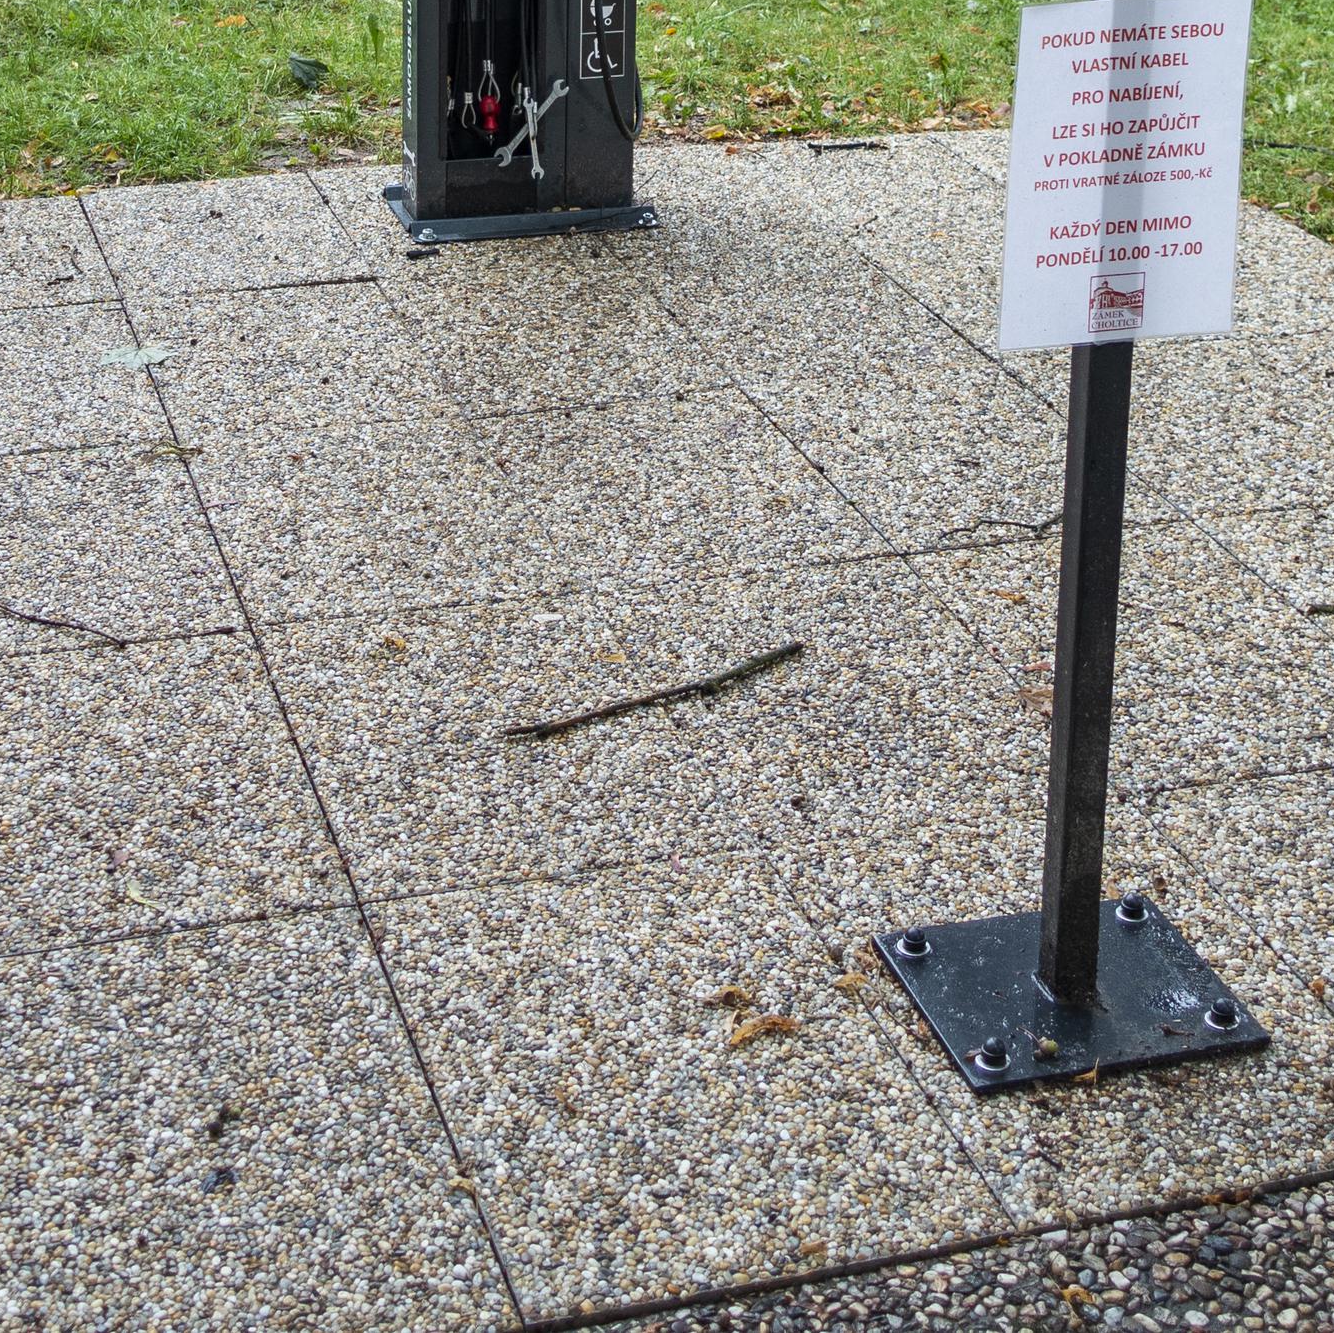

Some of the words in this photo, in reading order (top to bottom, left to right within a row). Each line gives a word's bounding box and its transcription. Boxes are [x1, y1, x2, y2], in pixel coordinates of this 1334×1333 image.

[1042, 31, 1095, 49] POKUD
[1100, 24, 1166, 43] NEMÁTE
[1171, 24, 1224, 39] SEBOU
[1072, 52, 1136, 74] VLASTNÍ
[1141, 52, 1189, 69] KABEL
[1072, 90, 1104, 105] PRO
[1109, 81, 1183, 103] NABÍJENÍ,
[1053, 124, 1076, 139] LZE
[1082, 123, 1095, 137] SI
[1100, 121, 1124, 136] HO
[1129, 113, 1200, 134] ZAPŮJČIT
[1044, 155, 1054, 167] V
[1059, 144, 1143, 166] POKLADNĚ
[1147, 142, 1205, 159] ZÁMKU
[1035, 179, 1069, 192] PROTI
[1073, 173, 1120, 187] VRATNÉ
[1123, 171, 1166, 184] ZÁLOZE
[1171, 167, 1212, 180] 500,-Kč
[1050, 220, 1101, 239] KAŽDÝ
[1106, 220, 1137, 235] DEN
[1142, 216, 1191, 232] MIMO
[1036, 246, 1105, 267] PONDĚLÍ
[1109, 245, 1150, 261] 10.00
[1156, 242, 1202, 257] -17.00
[1092, 317, 1138, 329] CHOLTICE
